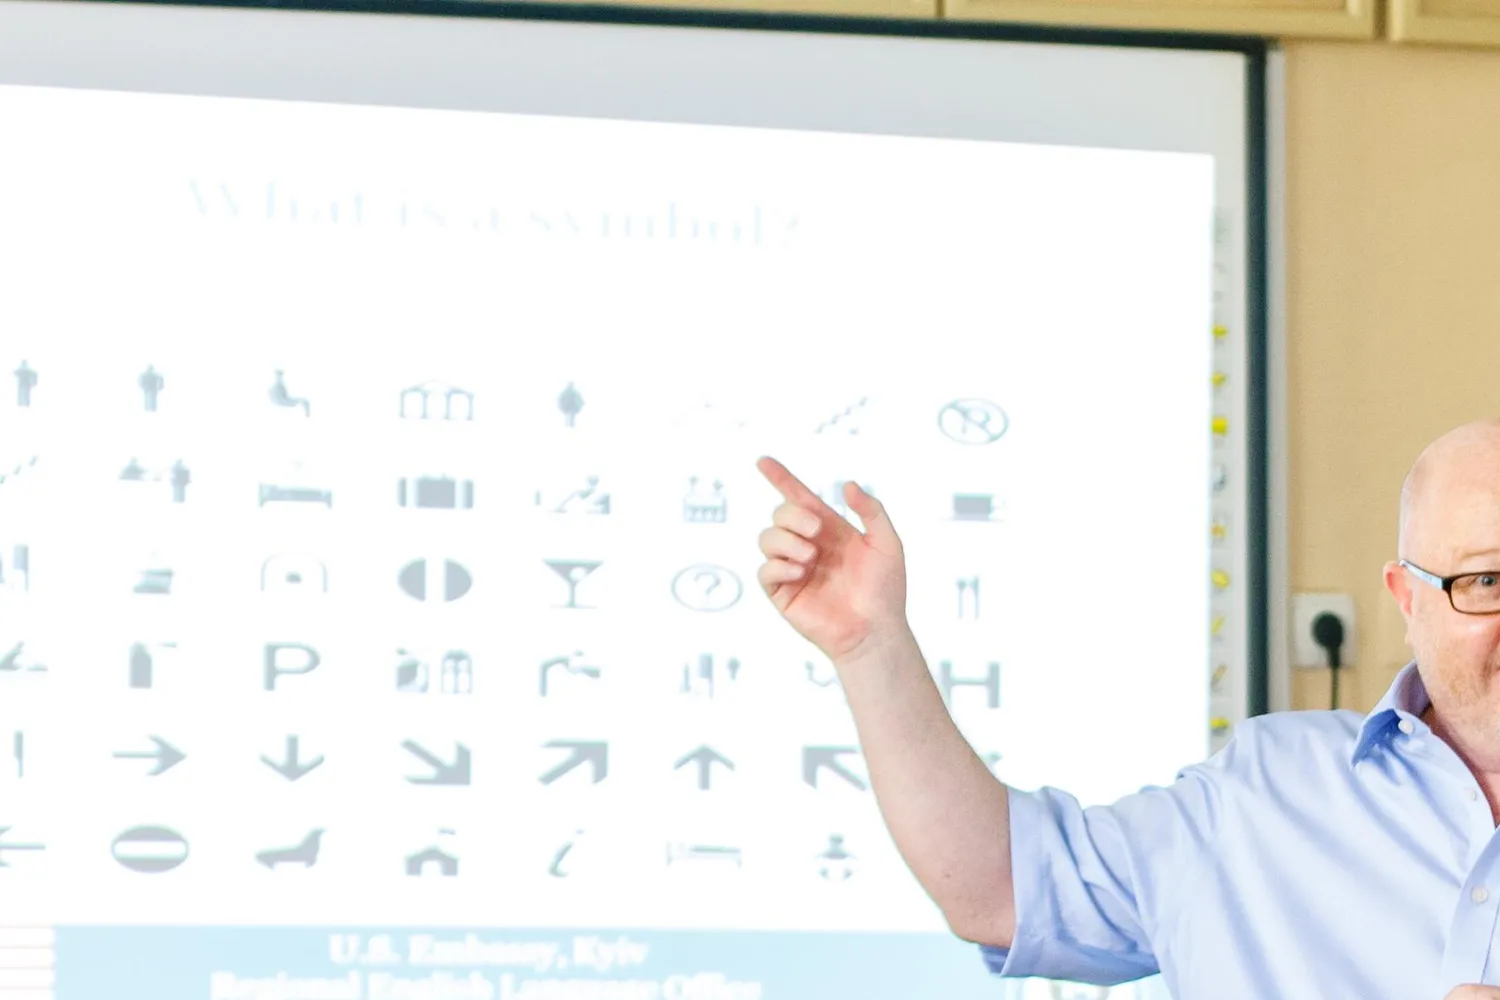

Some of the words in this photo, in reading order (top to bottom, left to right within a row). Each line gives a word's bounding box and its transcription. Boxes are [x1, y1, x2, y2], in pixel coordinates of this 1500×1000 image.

[184, 175, 368, 229] What
[399, 187, 449, 230] is
[470, 205, 507, 236] a
[525, 200, 803, 252] symbol?
[262, 641, 321, 692] P
[327, 932, 401, 965] U.S.
[408, 931, 567, 972] Embassy,
[572, 934, 649, 971] Kyiv
